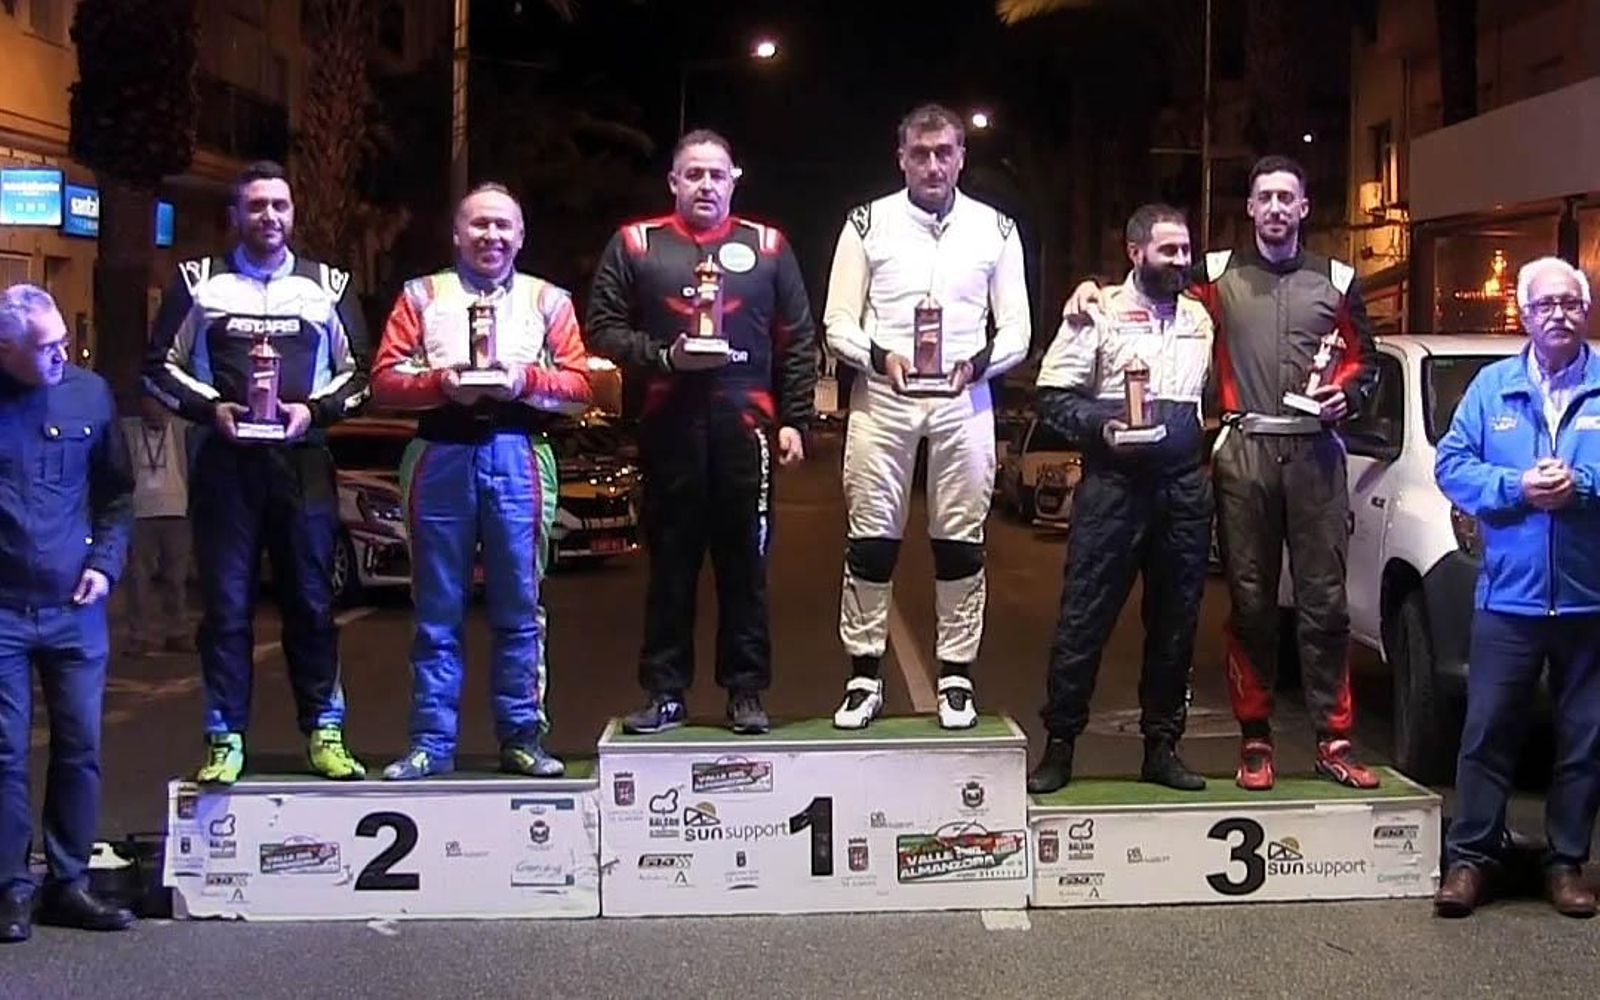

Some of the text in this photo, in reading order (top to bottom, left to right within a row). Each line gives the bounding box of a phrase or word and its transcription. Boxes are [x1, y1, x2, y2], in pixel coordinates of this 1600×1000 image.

[354, 811, 420, 891] 2
[789, 796, 833, 876] 1
[900, 855, 996, 878] ALMANZORA
[906, 851, 954, 866] VALLE
[1206, 817, 1266, 895] 3
